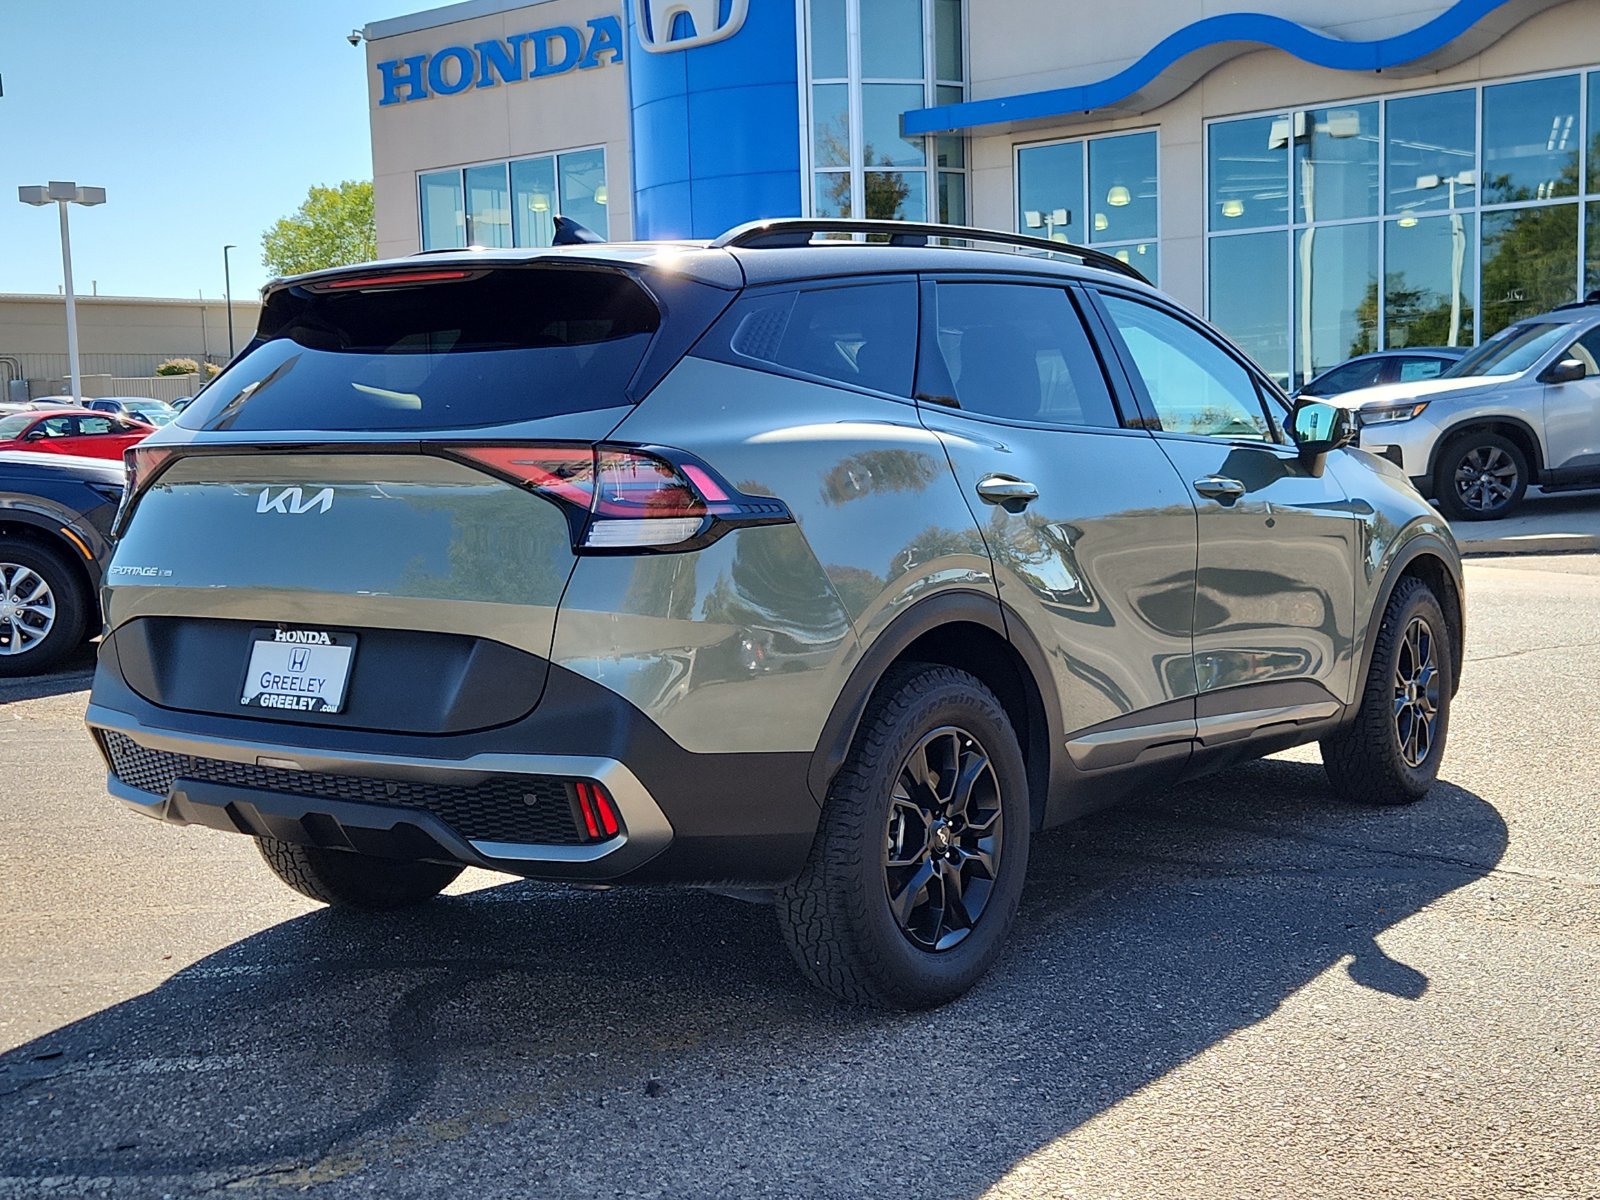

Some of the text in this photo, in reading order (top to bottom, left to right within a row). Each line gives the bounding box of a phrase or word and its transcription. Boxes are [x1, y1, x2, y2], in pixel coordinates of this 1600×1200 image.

[376, 15, 624, 107] HONDA
[256, 487, 335, 514] KIA
[274, 629, 332, 645] HONDA
[260, 671, 327, 693] GREELEY
[260, 694, 317, 711] GREELEY
